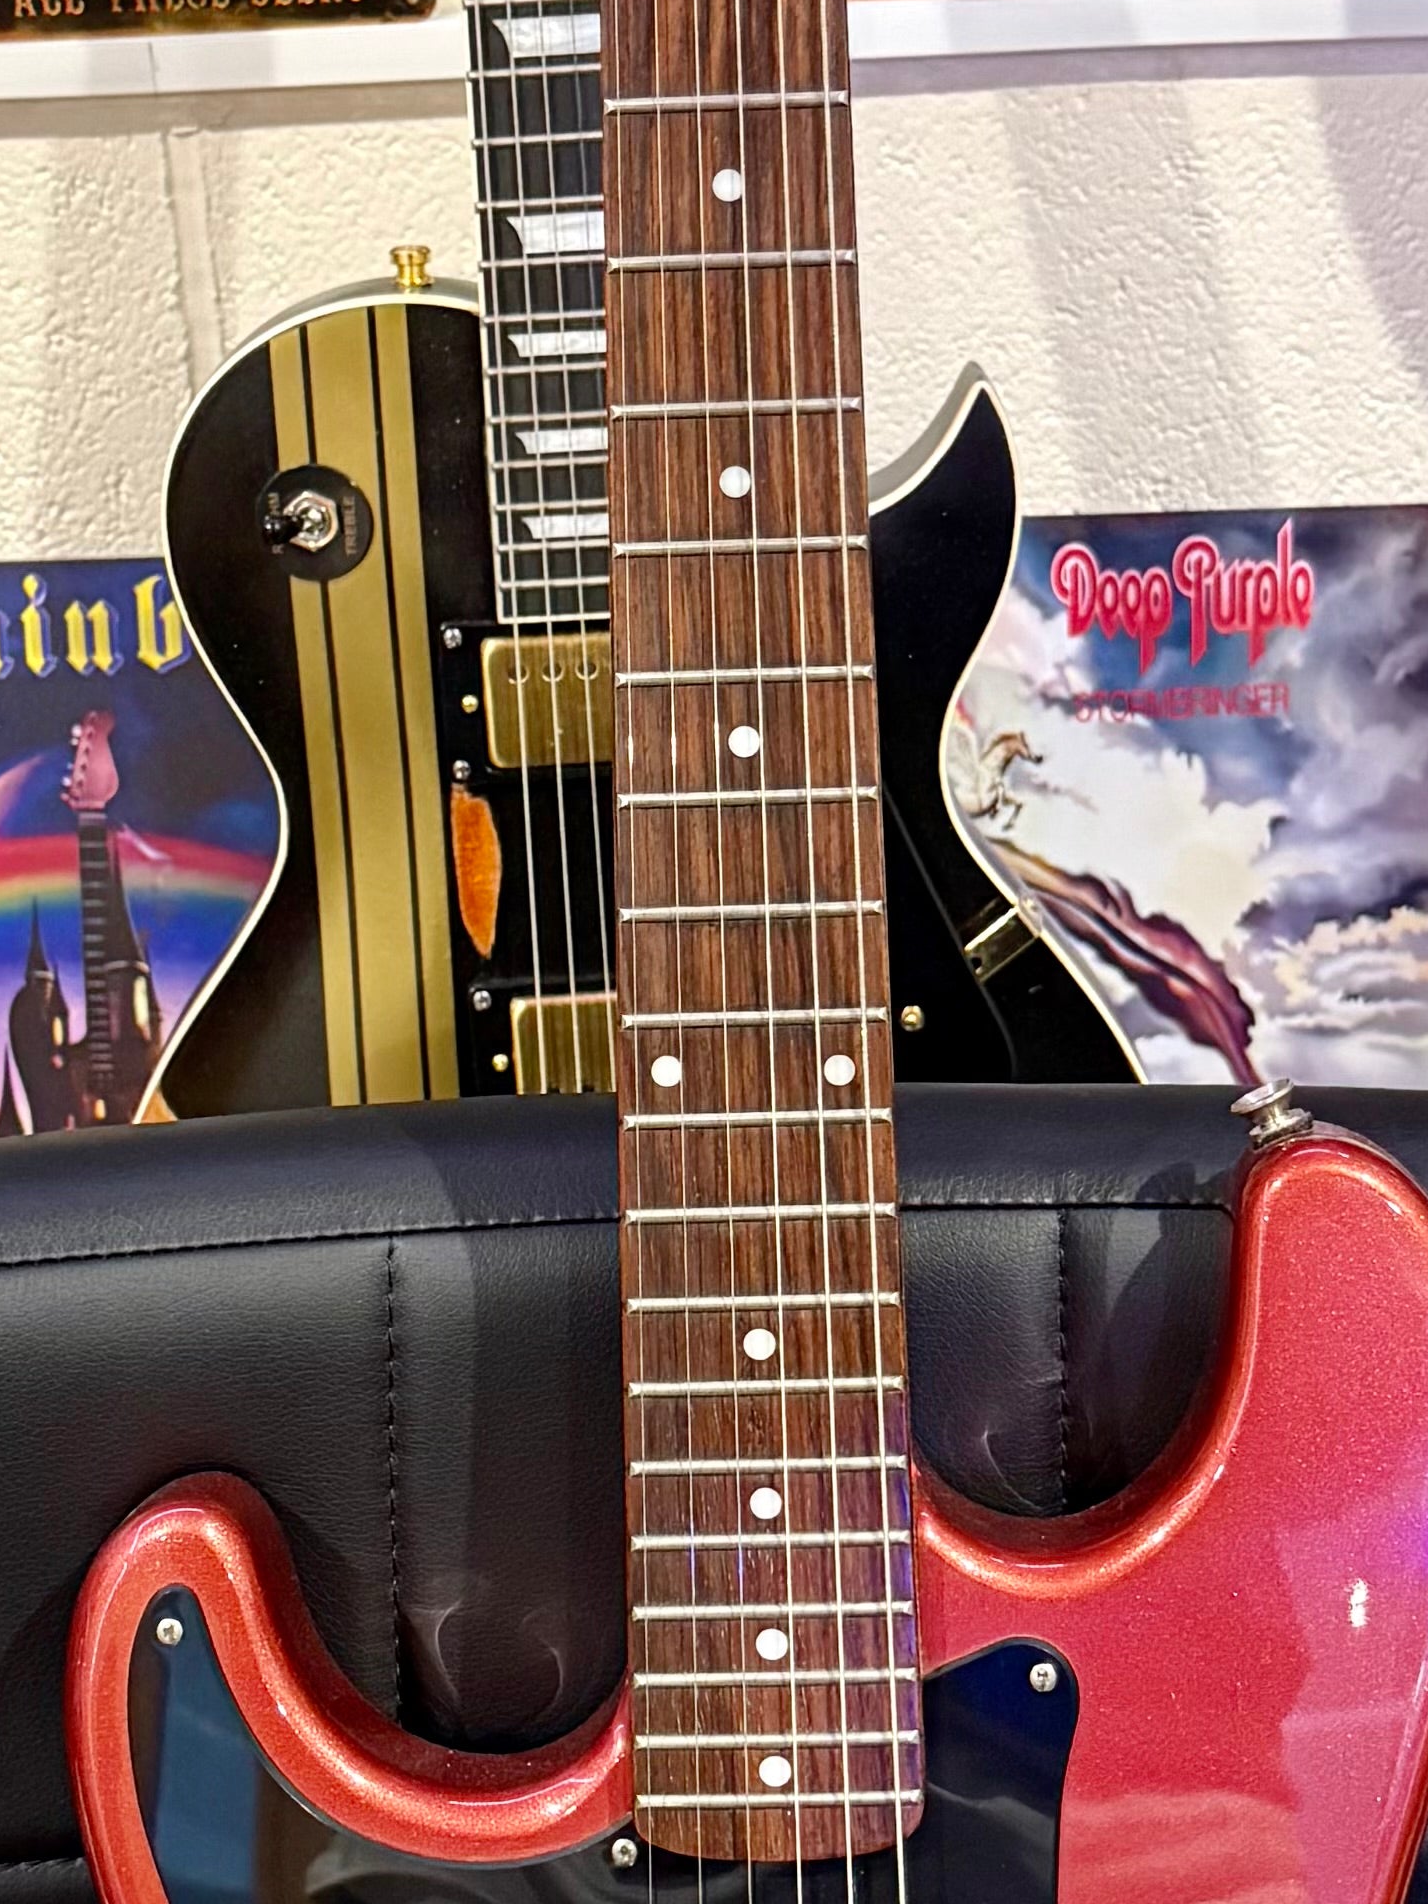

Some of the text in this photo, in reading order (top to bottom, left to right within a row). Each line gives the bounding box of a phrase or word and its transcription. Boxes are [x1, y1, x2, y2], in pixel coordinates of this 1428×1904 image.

[1049, 517, 1317, 678] Deep Purple
[1073, 684, 1290, 723] STORMBRINGER
